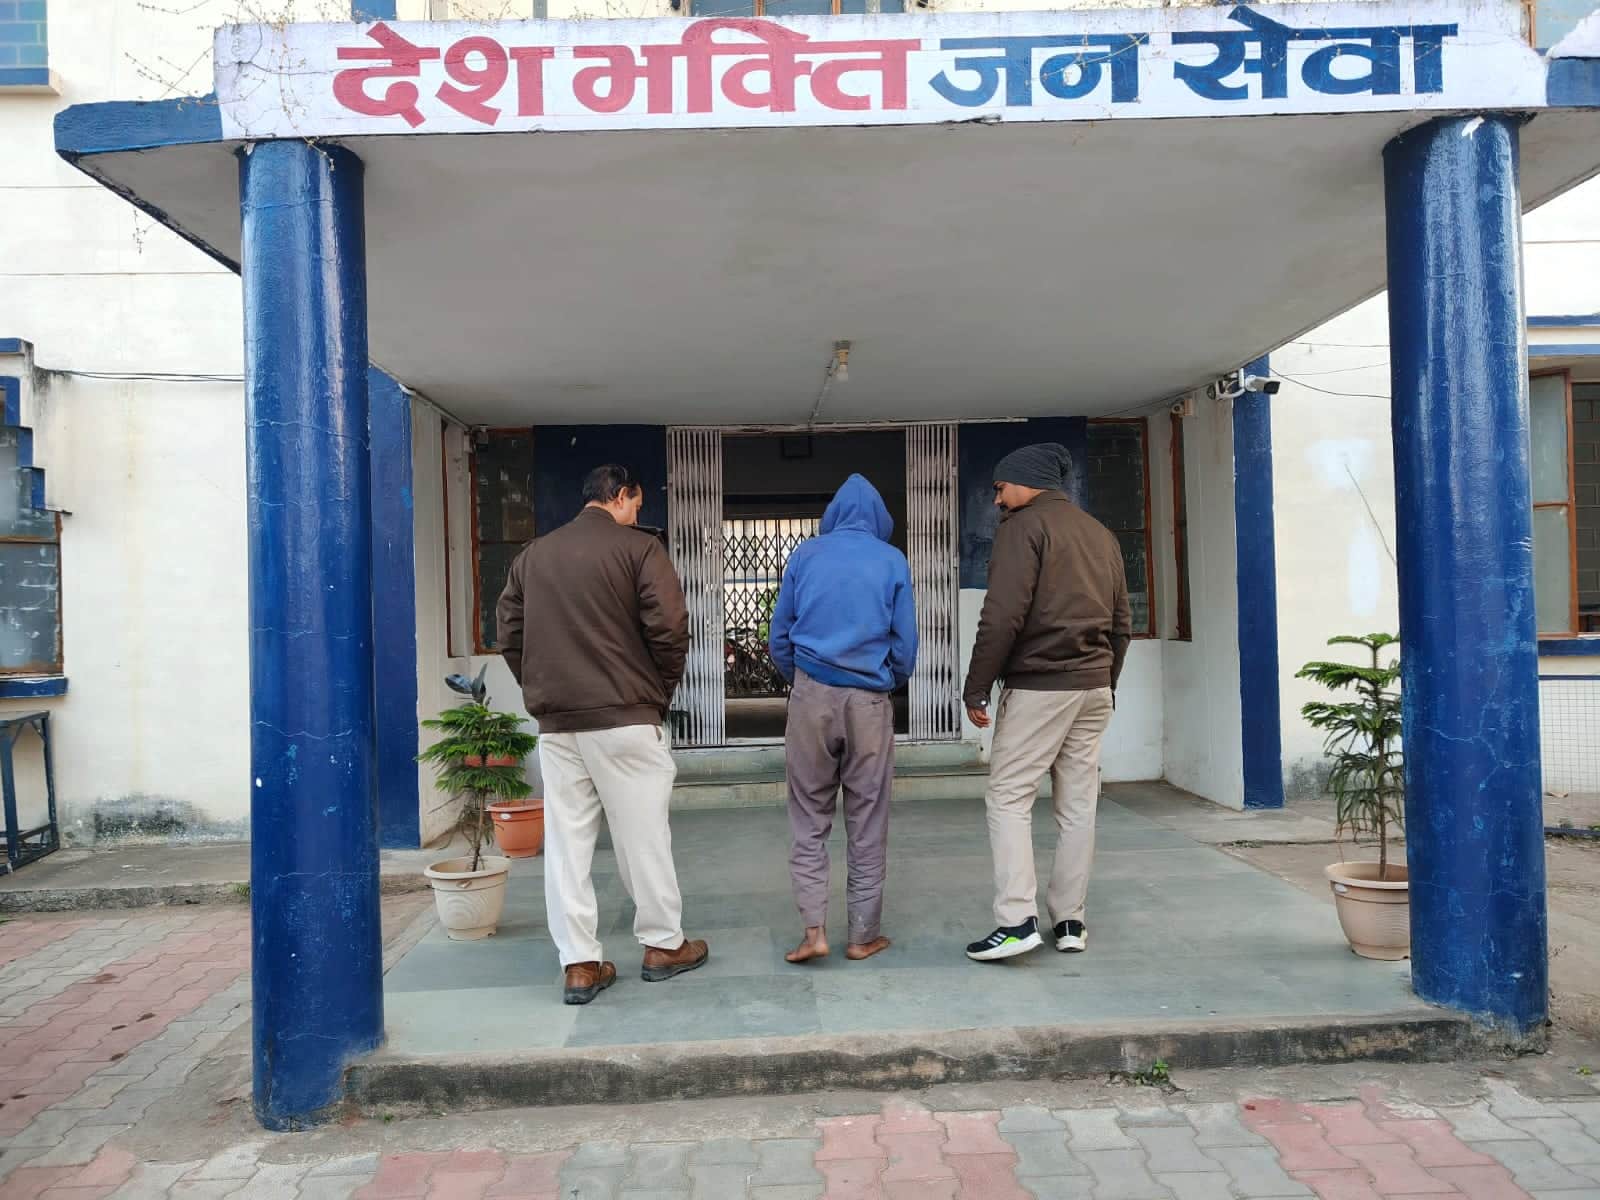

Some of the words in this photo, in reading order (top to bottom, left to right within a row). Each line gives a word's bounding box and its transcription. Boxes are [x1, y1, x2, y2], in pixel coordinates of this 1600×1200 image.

[333, 21, 555, 128] देश
[572, 17, 920, 114] भक्ति
[928, 32, 1150, 107] जन
[1171, 5, 1459, 101] सेवा
